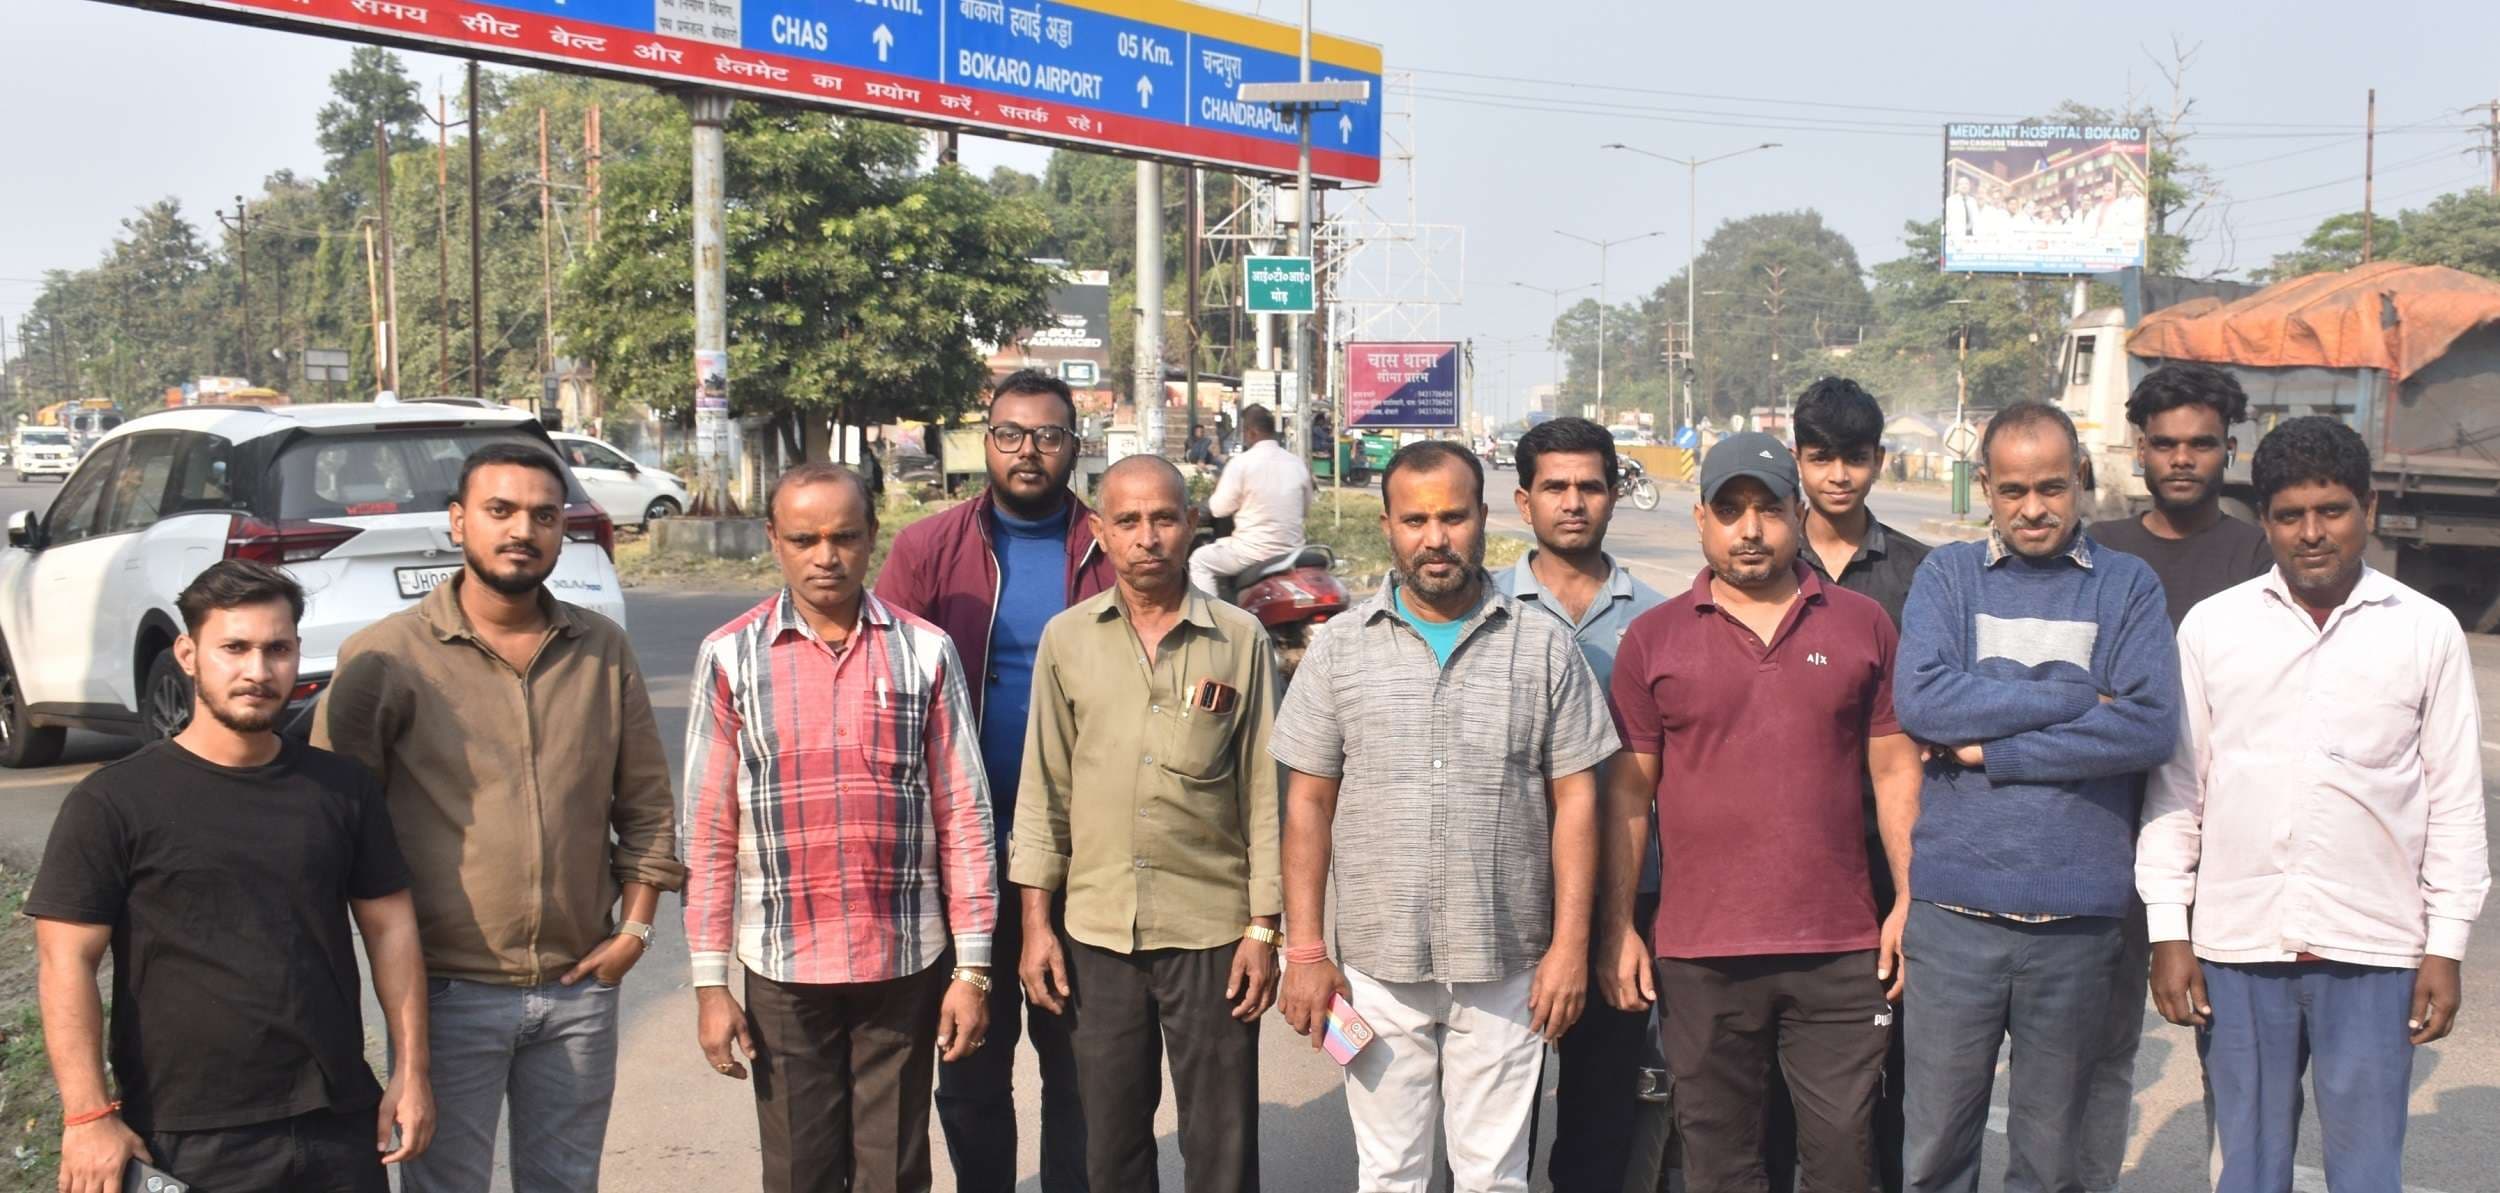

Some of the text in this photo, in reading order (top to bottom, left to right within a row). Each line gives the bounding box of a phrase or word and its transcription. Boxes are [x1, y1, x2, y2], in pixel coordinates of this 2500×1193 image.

[771, 14, 828, 51] CHAS
[1010, 4, 1041, 43] हवाई
[1045, 15, 1073, 48] अड्डा
[353, 0, 428, 23] समय
[461, 12, 521, 38] सीट
[550, 25, 607, 51] बेल्ट
[633, 42, 684, 64] और
[714, 53, 789, 81] हेलमेट
[812, 73, 843, 91] का
[866, 82, 920, 103] प्रयोग
[998, 104, 1048, 123] सतर्क
[1118, 32, 1174, 66] 05 Km.
[959, 49, 1103, 99] BOKARO AIRPORT
[1202, 49, 1242, 88] चन्द्रपुरा
[1950, 125, 2140, 141] MEDICANT HOSPITAL BOKARO
[1028, 337, 1101, 348] ADVANCED
[1047, 328, 1086, 338] BOLD
[1367, 353, 1439, 368] चास थाना
[1376, 369, 1401, 383] सीमा
